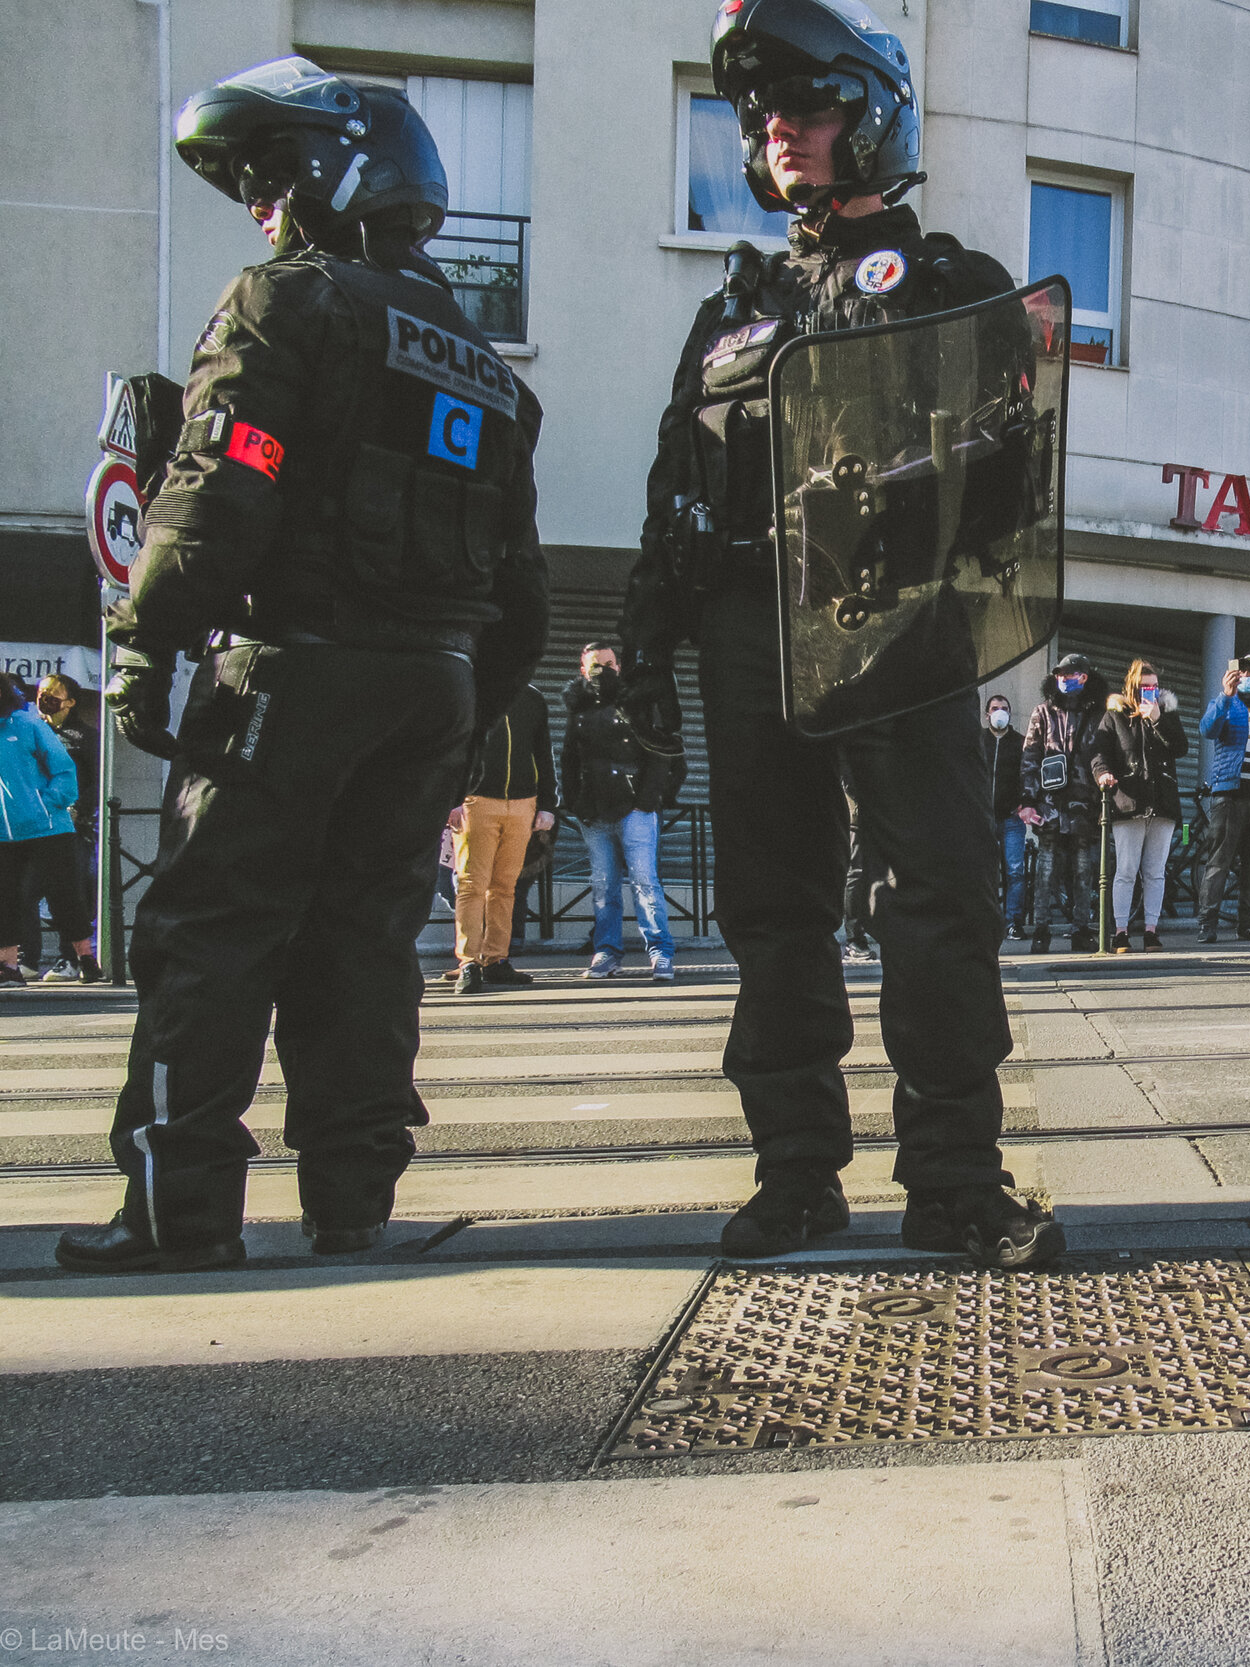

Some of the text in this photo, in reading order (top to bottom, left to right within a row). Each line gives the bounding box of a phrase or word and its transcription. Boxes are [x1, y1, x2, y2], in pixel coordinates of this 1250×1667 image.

[397, 316, 516, 401] POLICE
[443, 407, 470, 457] C
[240, 692, 271, 760] BERING
